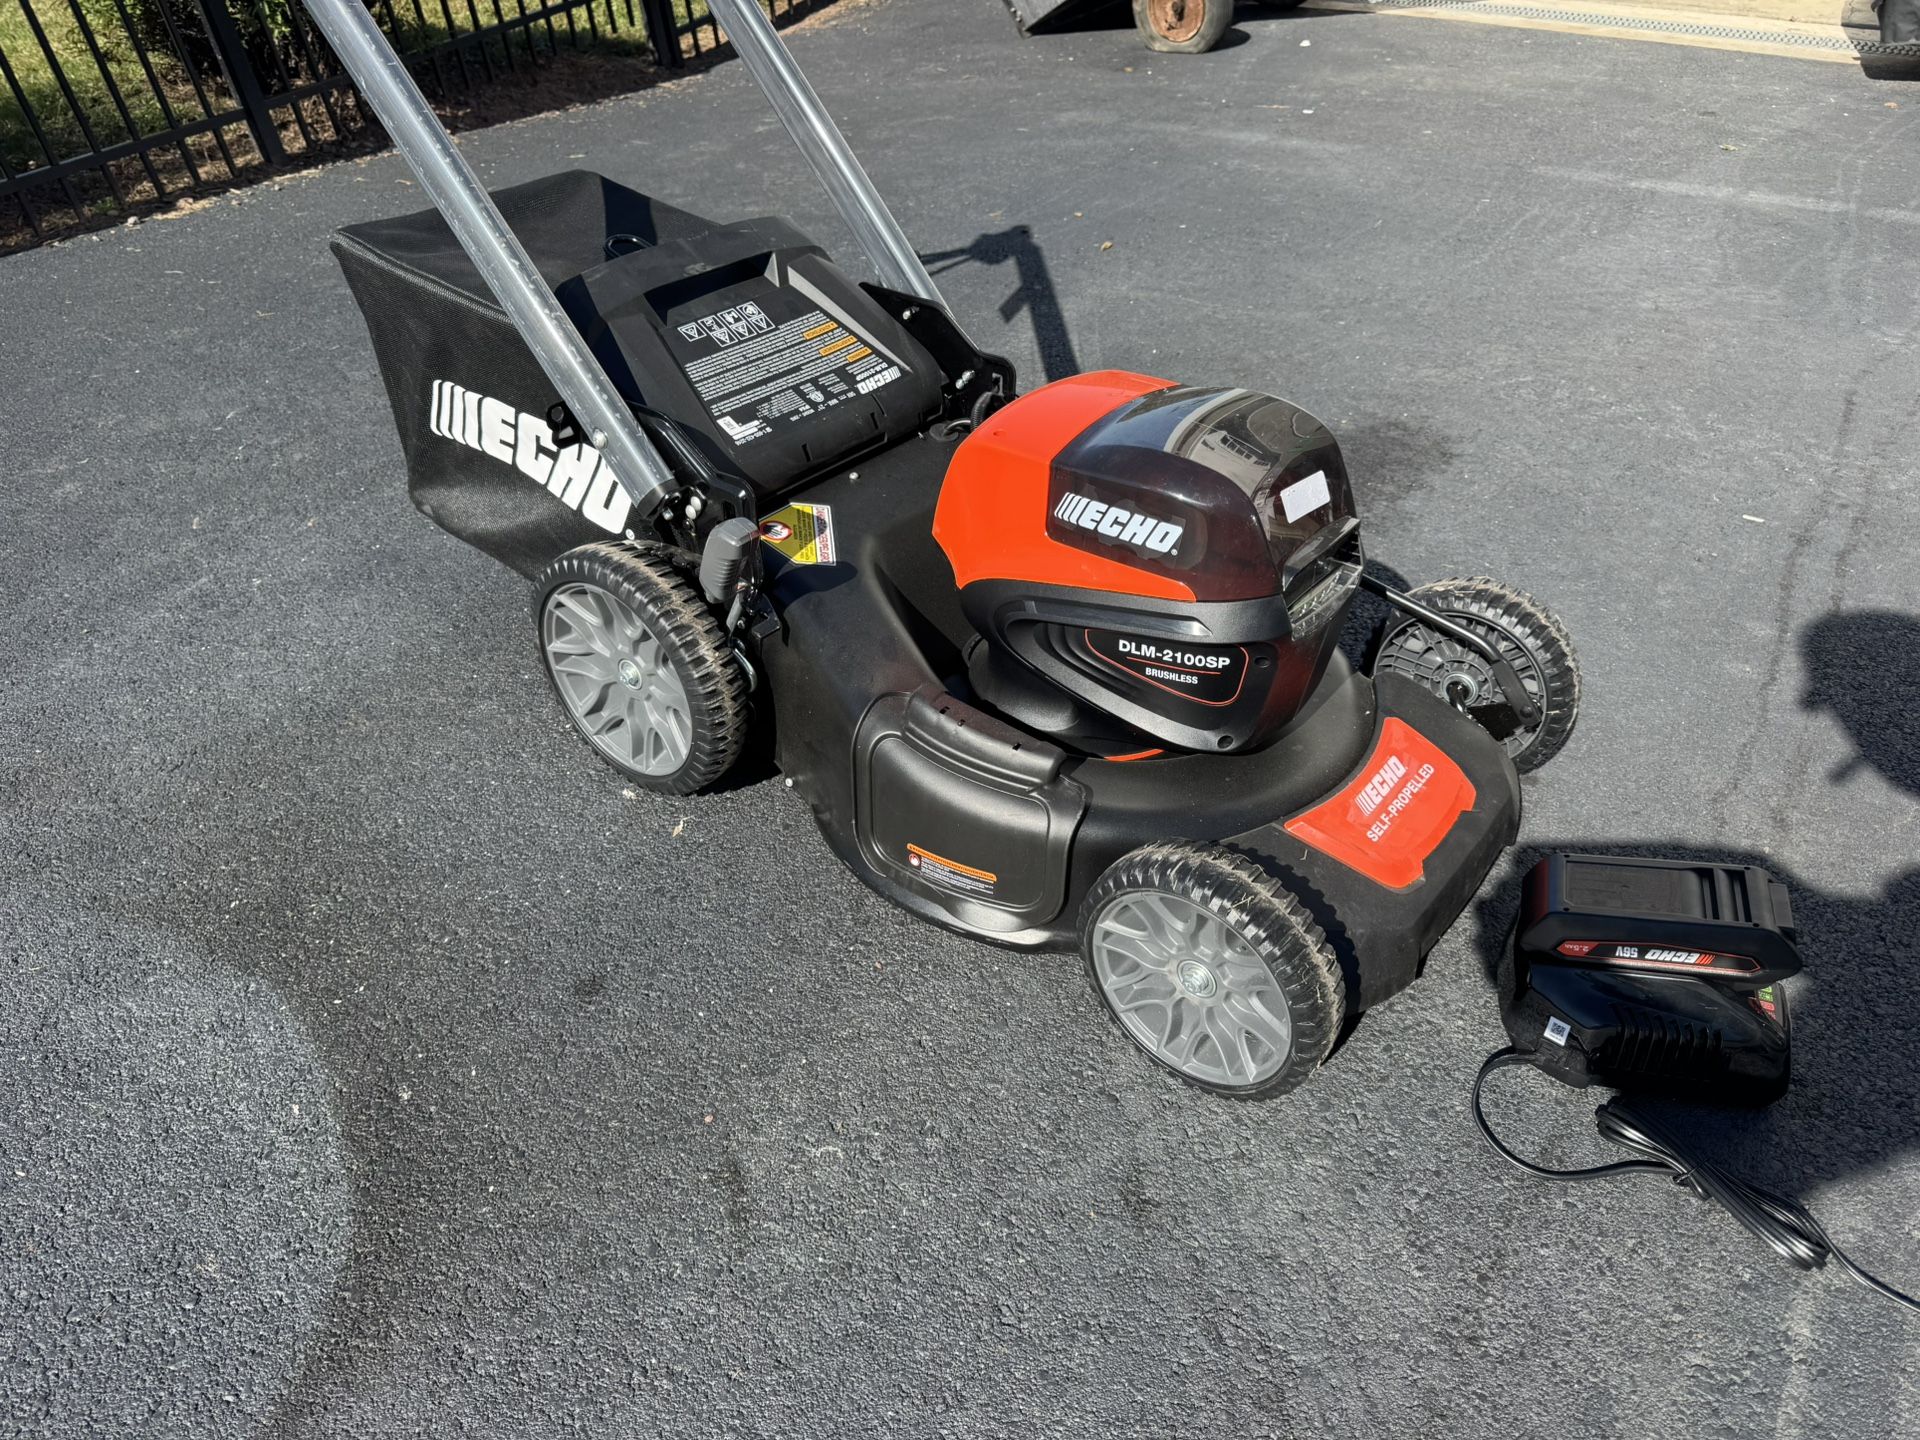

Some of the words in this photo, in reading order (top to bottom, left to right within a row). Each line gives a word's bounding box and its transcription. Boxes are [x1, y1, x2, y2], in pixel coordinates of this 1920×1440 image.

[855, 368, 893, 395] ECHO
[480, 396, 633, 534] ECHO
[1078, 497, 1184, 553] ECHO
[1117, 638, 1231, 669] DLM-2100SP
[1145, 667, 1199, 684] BRUSHLESS
[1367, 755, 1407, 805] ECHO
[1366, 763, 1435, 842] SELF-PROPELLED
[1615, 946, 1639, 958] 56V
[1644, 949, 1700, 963] ECHO
